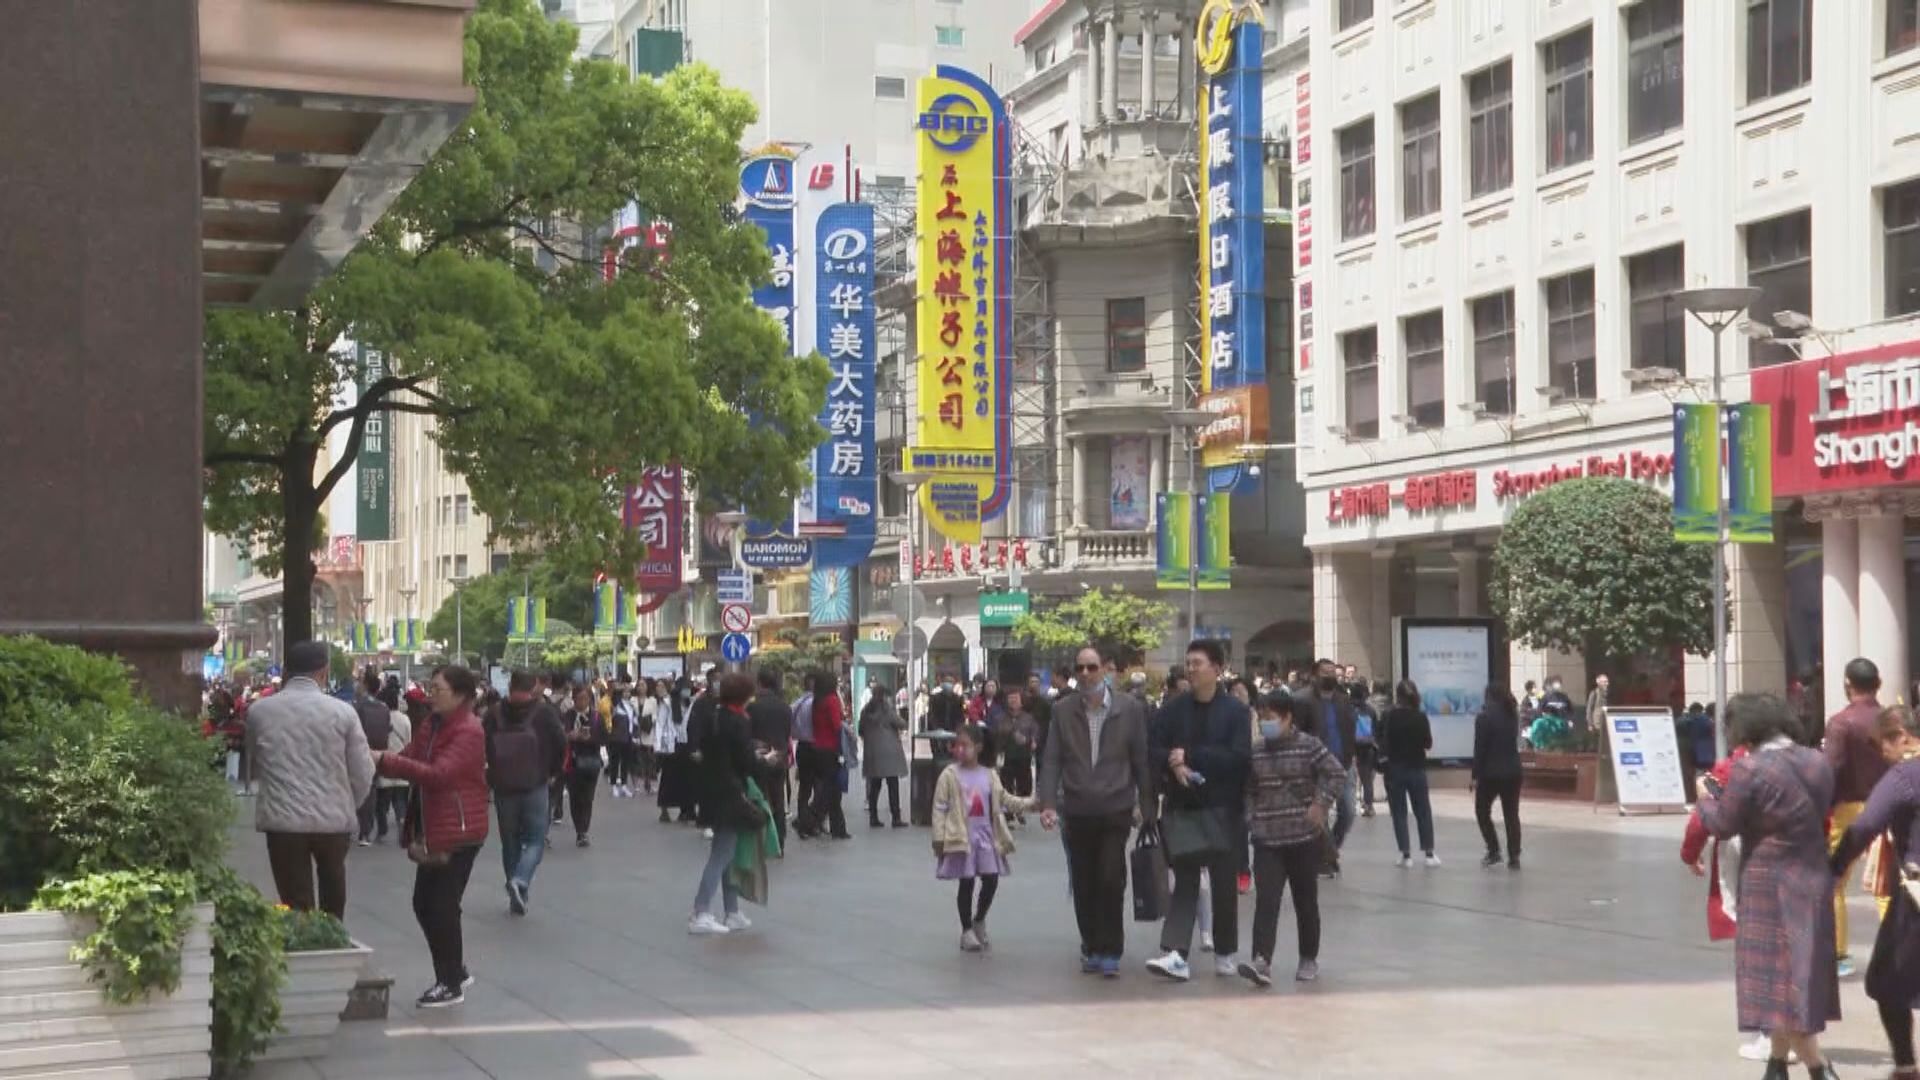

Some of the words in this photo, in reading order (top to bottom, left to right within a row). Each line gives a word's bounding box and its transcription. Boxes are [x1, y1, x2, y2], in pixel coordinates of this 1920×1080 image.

[919, 112, 988, 133] BAC
[828, 282, 864, 477] 华美大药房
[1809, 358, 1920, 422] 上海市
[1327, 469, 1477, 522] 上海市第一食品商店
[1493, 459, 1582, 497] Shanghai
[1587, 454, 1626, 478] First
[1630, 450, 1674, 480] Foo
[640, 562, 672, 574] PTICAL
[744, 539, 808, 554] BAROMON
